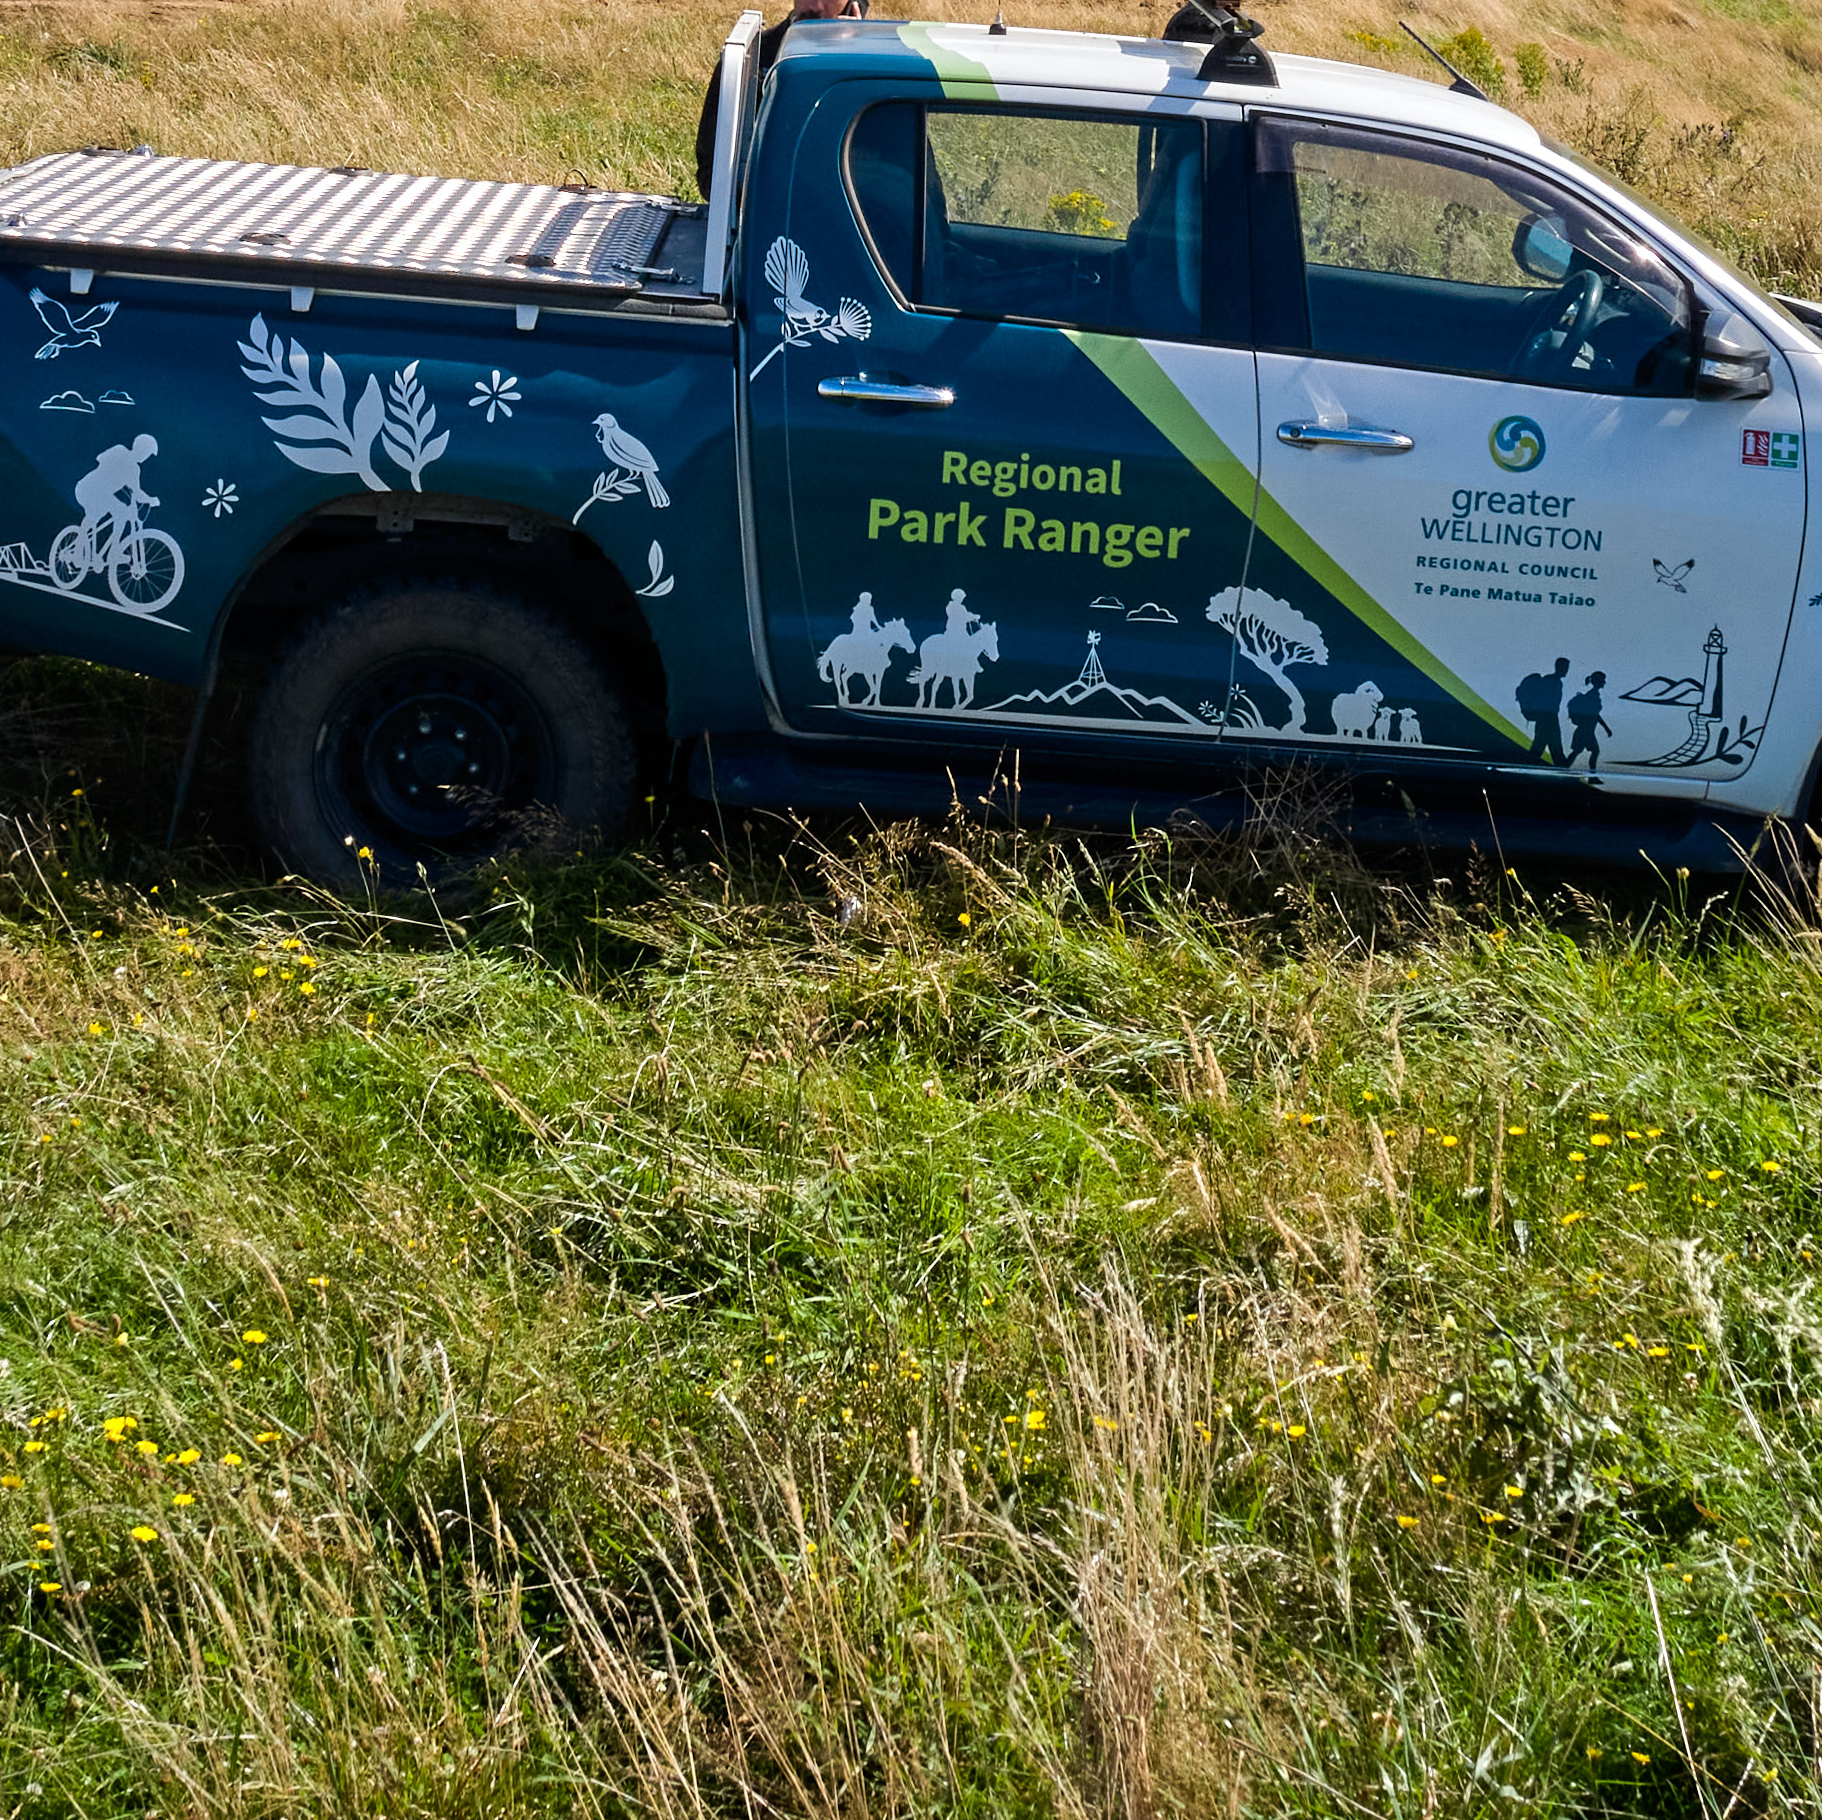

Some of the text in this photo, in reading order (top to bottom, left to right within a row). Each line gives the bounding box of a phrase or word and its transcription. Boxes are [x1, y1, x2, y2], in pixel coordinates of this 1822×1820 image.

[942, 450, 1122, 497] Regional
[1452, 489, 1576, 519] greater
[868, 498, 1191, 568] Park Ranger
[1421, 517, 1603, 552] WELLINGTON
[1416, 556, 1598, 580] REGIONAL COUNCIL
[1414, 582, 1596, 607] Te Pane Matua Taiao
